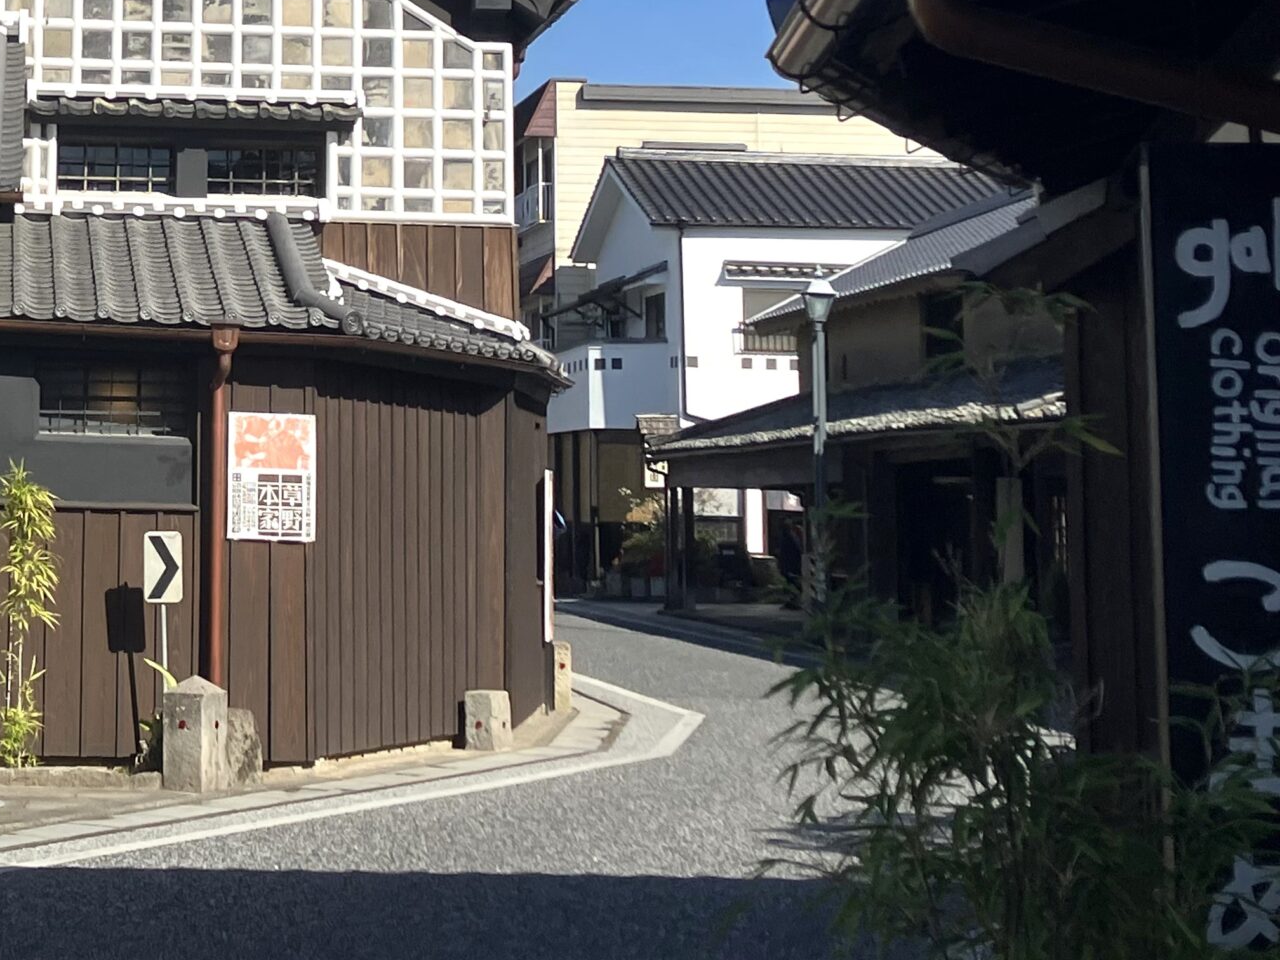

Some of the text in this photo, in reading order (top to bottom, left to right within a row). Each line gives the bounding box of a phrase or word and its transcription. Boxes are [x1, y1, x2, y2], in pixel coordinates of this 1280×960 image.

[1205, 327, 1252, 509] clothing
[258, 484, 279, 531] 本家
[281, 484, 303, 531] 草野
